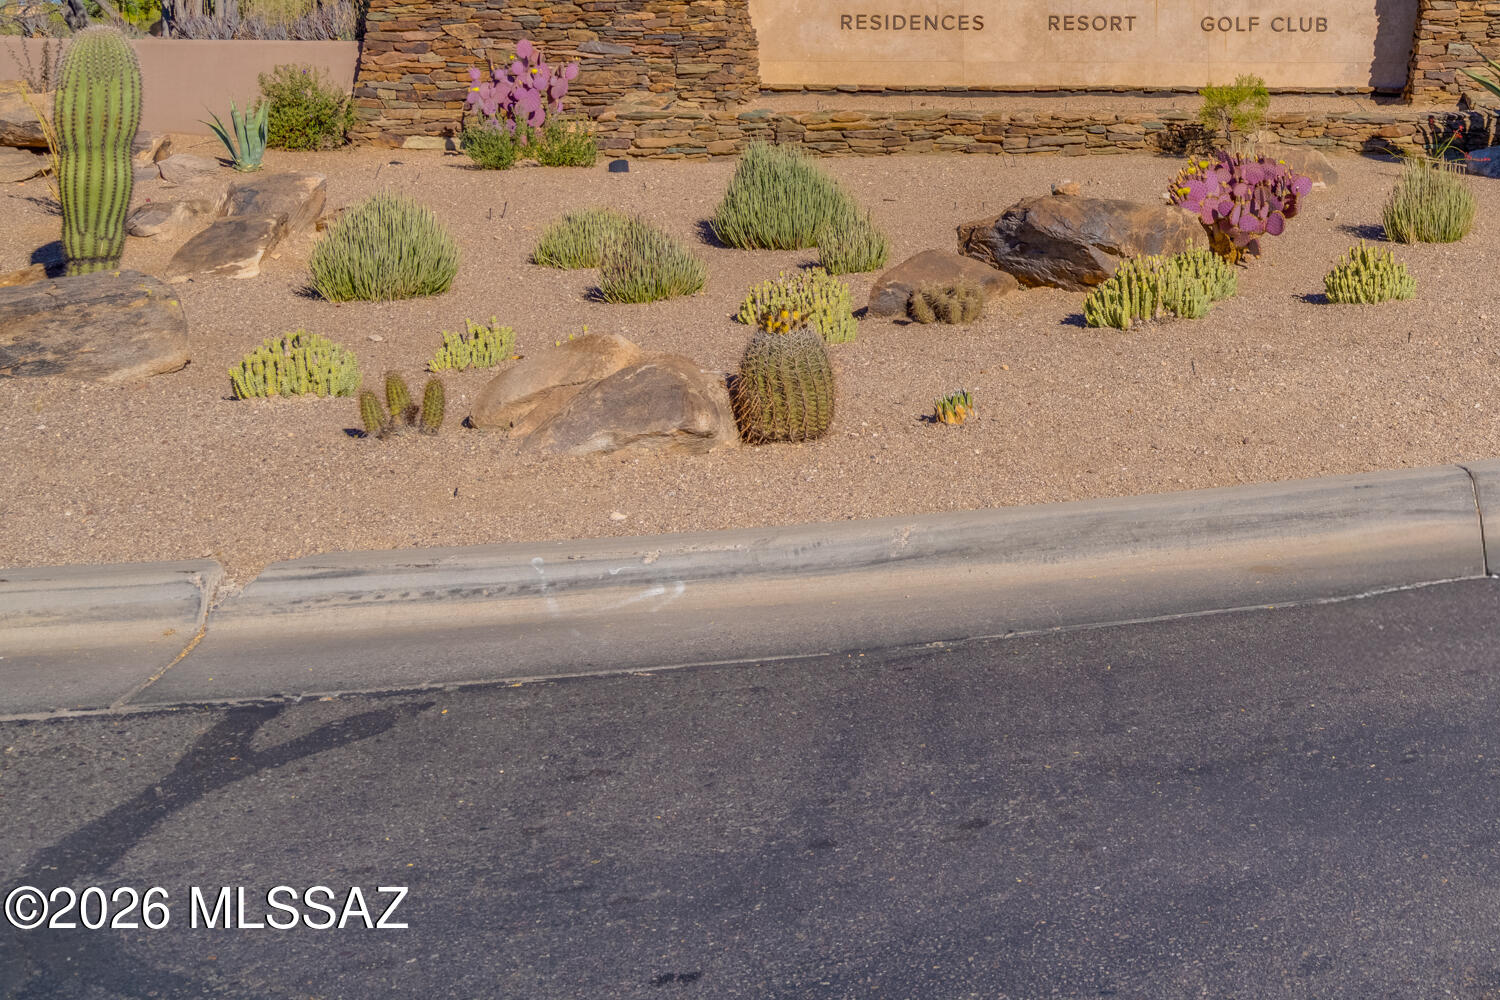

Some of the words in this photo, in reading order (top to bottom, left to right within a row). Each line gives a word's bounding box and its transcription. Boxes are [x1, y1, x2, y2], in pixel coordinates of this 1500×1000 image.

[840, 14, 985, 31] RESIDENCES
[1048, 15, 1137, 32] RESORT
[1200, 16, 1261, 33] GOLF
[1270, 17, 1329, 33] CLUB
